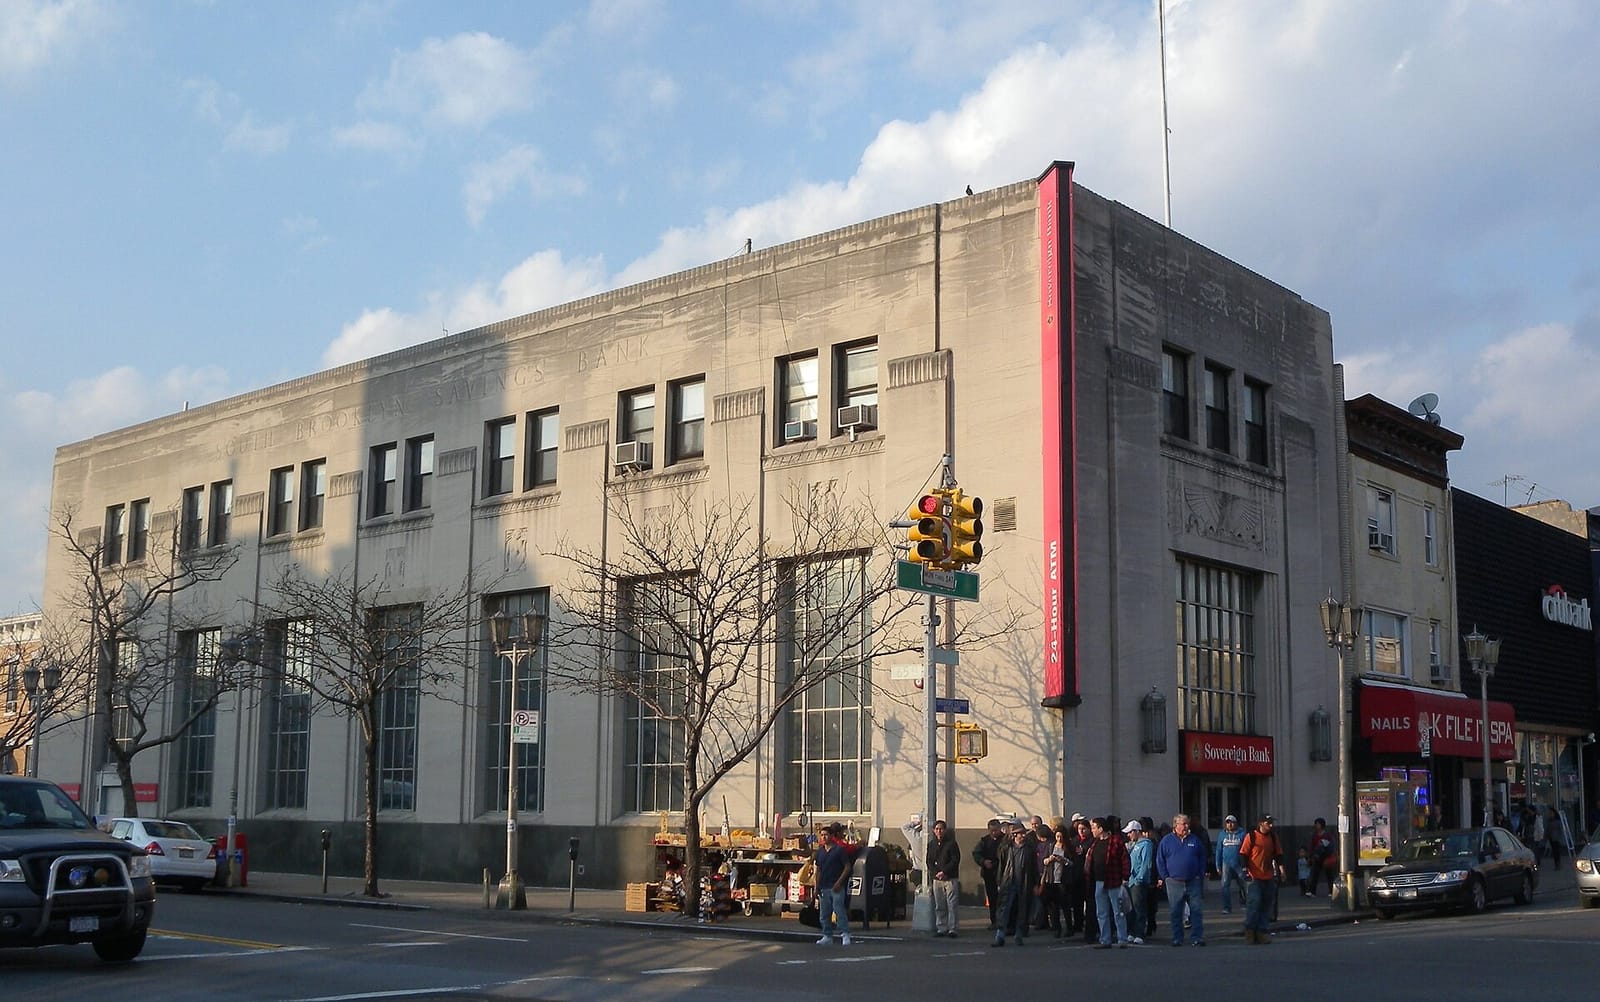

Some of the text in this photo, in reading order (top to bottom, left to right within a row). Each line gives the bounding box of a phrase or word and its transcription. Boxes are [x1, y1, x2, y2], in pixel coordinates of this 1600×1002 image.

[214, 431, 274, 460] SOUTH
[433, 364, 545, 406] SAVINGS
[577, 335, 650, 373] BANK
[1050, 588, 1058, 664] 24-Hour
[1371, 716, 1411, 730] NAILS
[1446, 714, 1473, 742] FILE
[1491, 720, 1514, 744] SPA
[1204, 743, 1270, 766] Sovereign Bank
